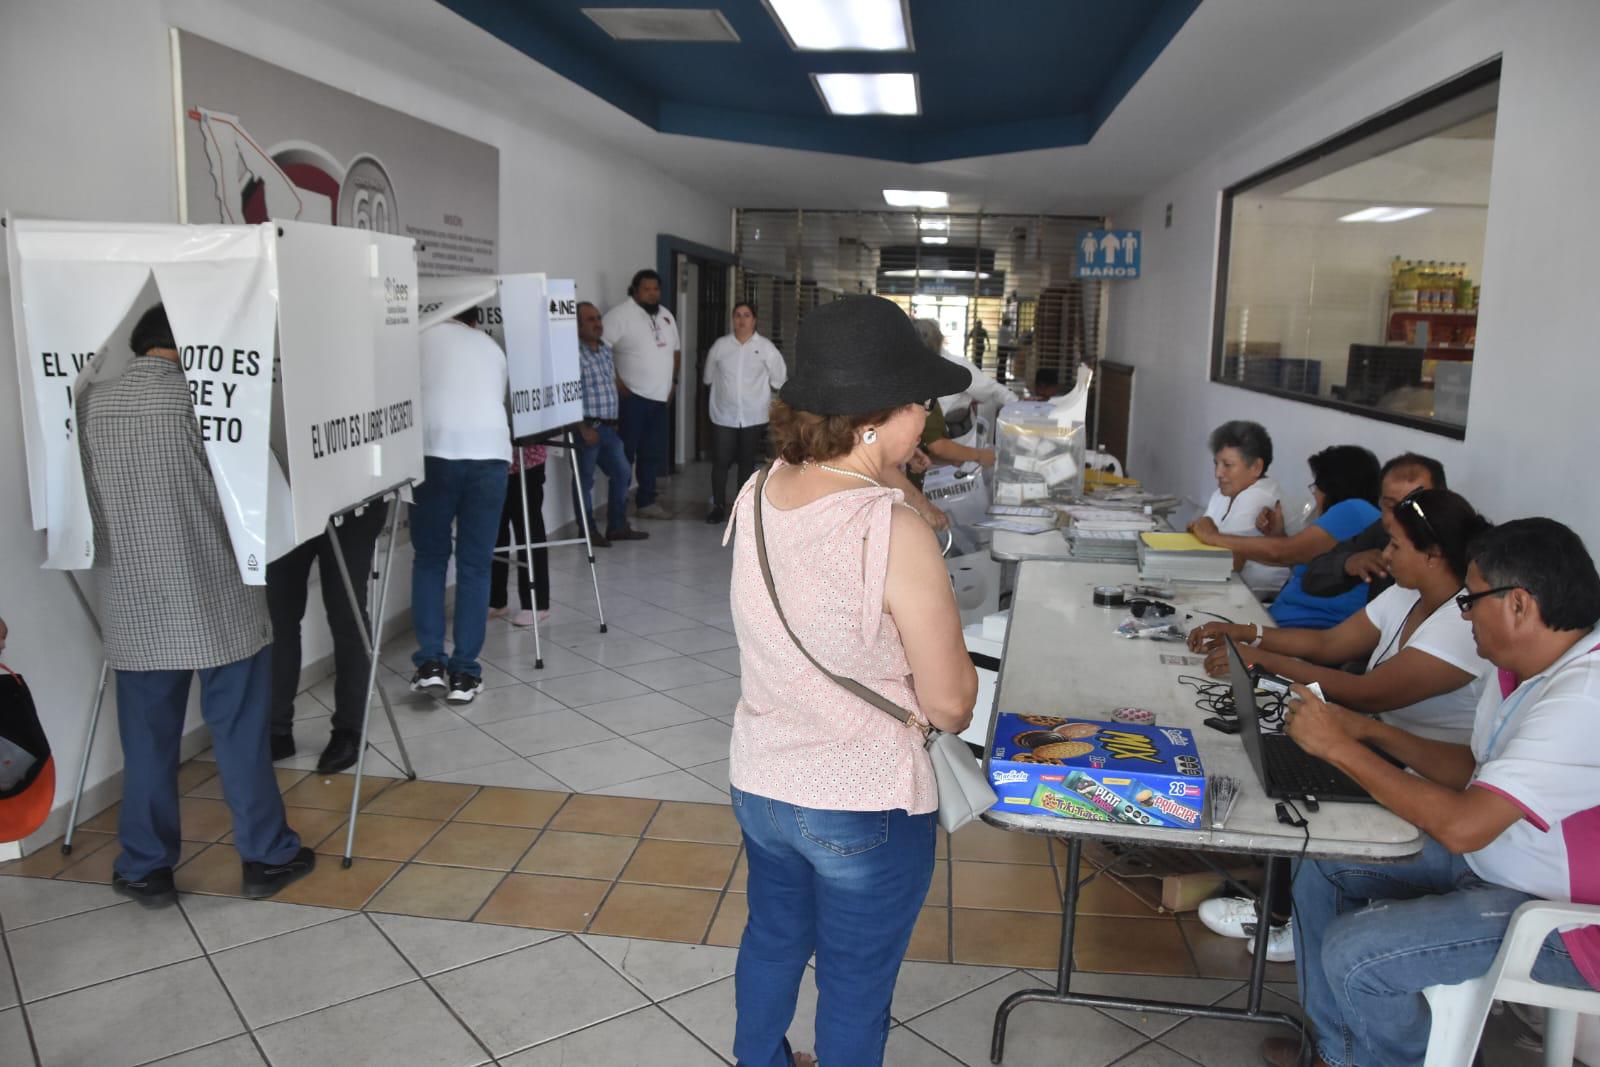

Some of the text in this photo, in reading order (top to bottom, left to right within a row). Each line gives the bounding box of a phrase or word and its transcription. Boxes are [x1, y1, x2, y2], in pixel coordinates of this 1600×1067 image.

[1080, 266, 1137, 276] BAÑOS
[558, 300, 576, 315] INE
[42, 352, 68, 377] EL
[180, 345, 224, 373] OTO
[232, 349, 260, 377] ES
[222, 382, 237, 408] Y
[531, 387, 541, 412] ES
[311, 424, 324, 459] EL
[323, 417, 348, 455] VOTO
[349, 413, 361, 448] ES
[362, 407, 384, 444] LIBRE
[388, 399, 413, 435] SECRETO
[1098, 729, 1165, 763] MIX
[1169, 782, 1186, 796] 28
